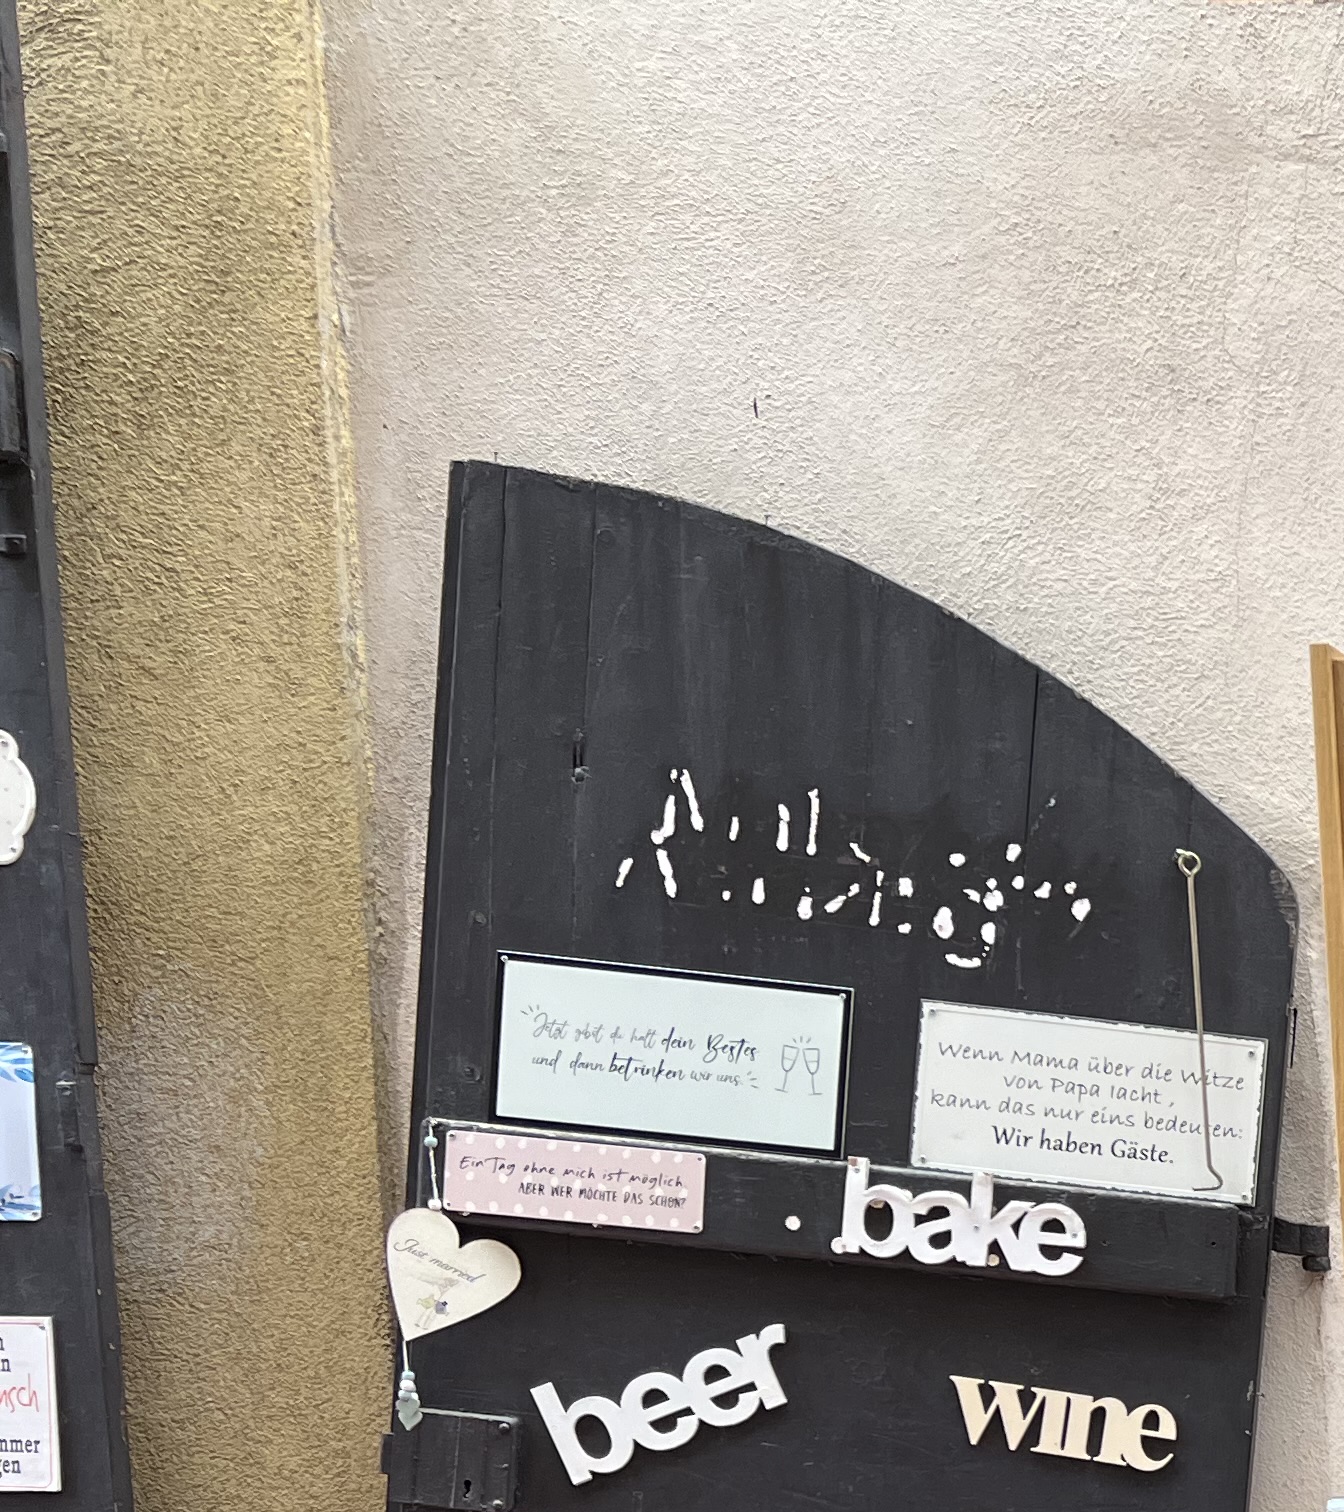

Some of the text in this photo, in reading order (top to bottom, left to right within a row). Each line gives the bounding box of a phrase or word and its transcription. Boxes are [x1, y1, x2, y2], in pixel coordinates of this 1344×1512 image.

[661, 1027, 696, 1053] dein
[702, 1033, 758, 1063] Bestes
[532, 1050, 562, 1074] und
[570, 1051, 604, 1076] dann
[609, 1052, 685, 1082] betrinken
[939, 1042, 1244, 1090] Wenn Mama über die Witze
[1004, 1075, 1043, 1089] von
[1051, 1077, 1100, 1102] Papa
[931, 1089, 991, 1110] kann
[998, 1097, 1035, 1117] das
[1044, 1106, 1083, 1121] nur
[1090, 1109, 1136, 1128] eins
[992, 1125, 1174, 1164] Wir haben Gäste.
[459, 1156, 484, 1170] Ein
[485, 1156, 516, 1175] Tag
[523, 1162, 555, 1175] ohne
[563, 1167, 596, 1180] mich
[603, 1169, 629, 1183] ist
[518, 1182, 545, 1196] ABER
[551, 1185, 573, 1198] WER
[623, 1191, 643, 1205] DAS
[838, 1156, 1087, 1277] bake
[393, 1239, 487, 1283] Just married
[530, 1322, 788, 1487] beer
[948, 1374, 1178, 1474] wine
